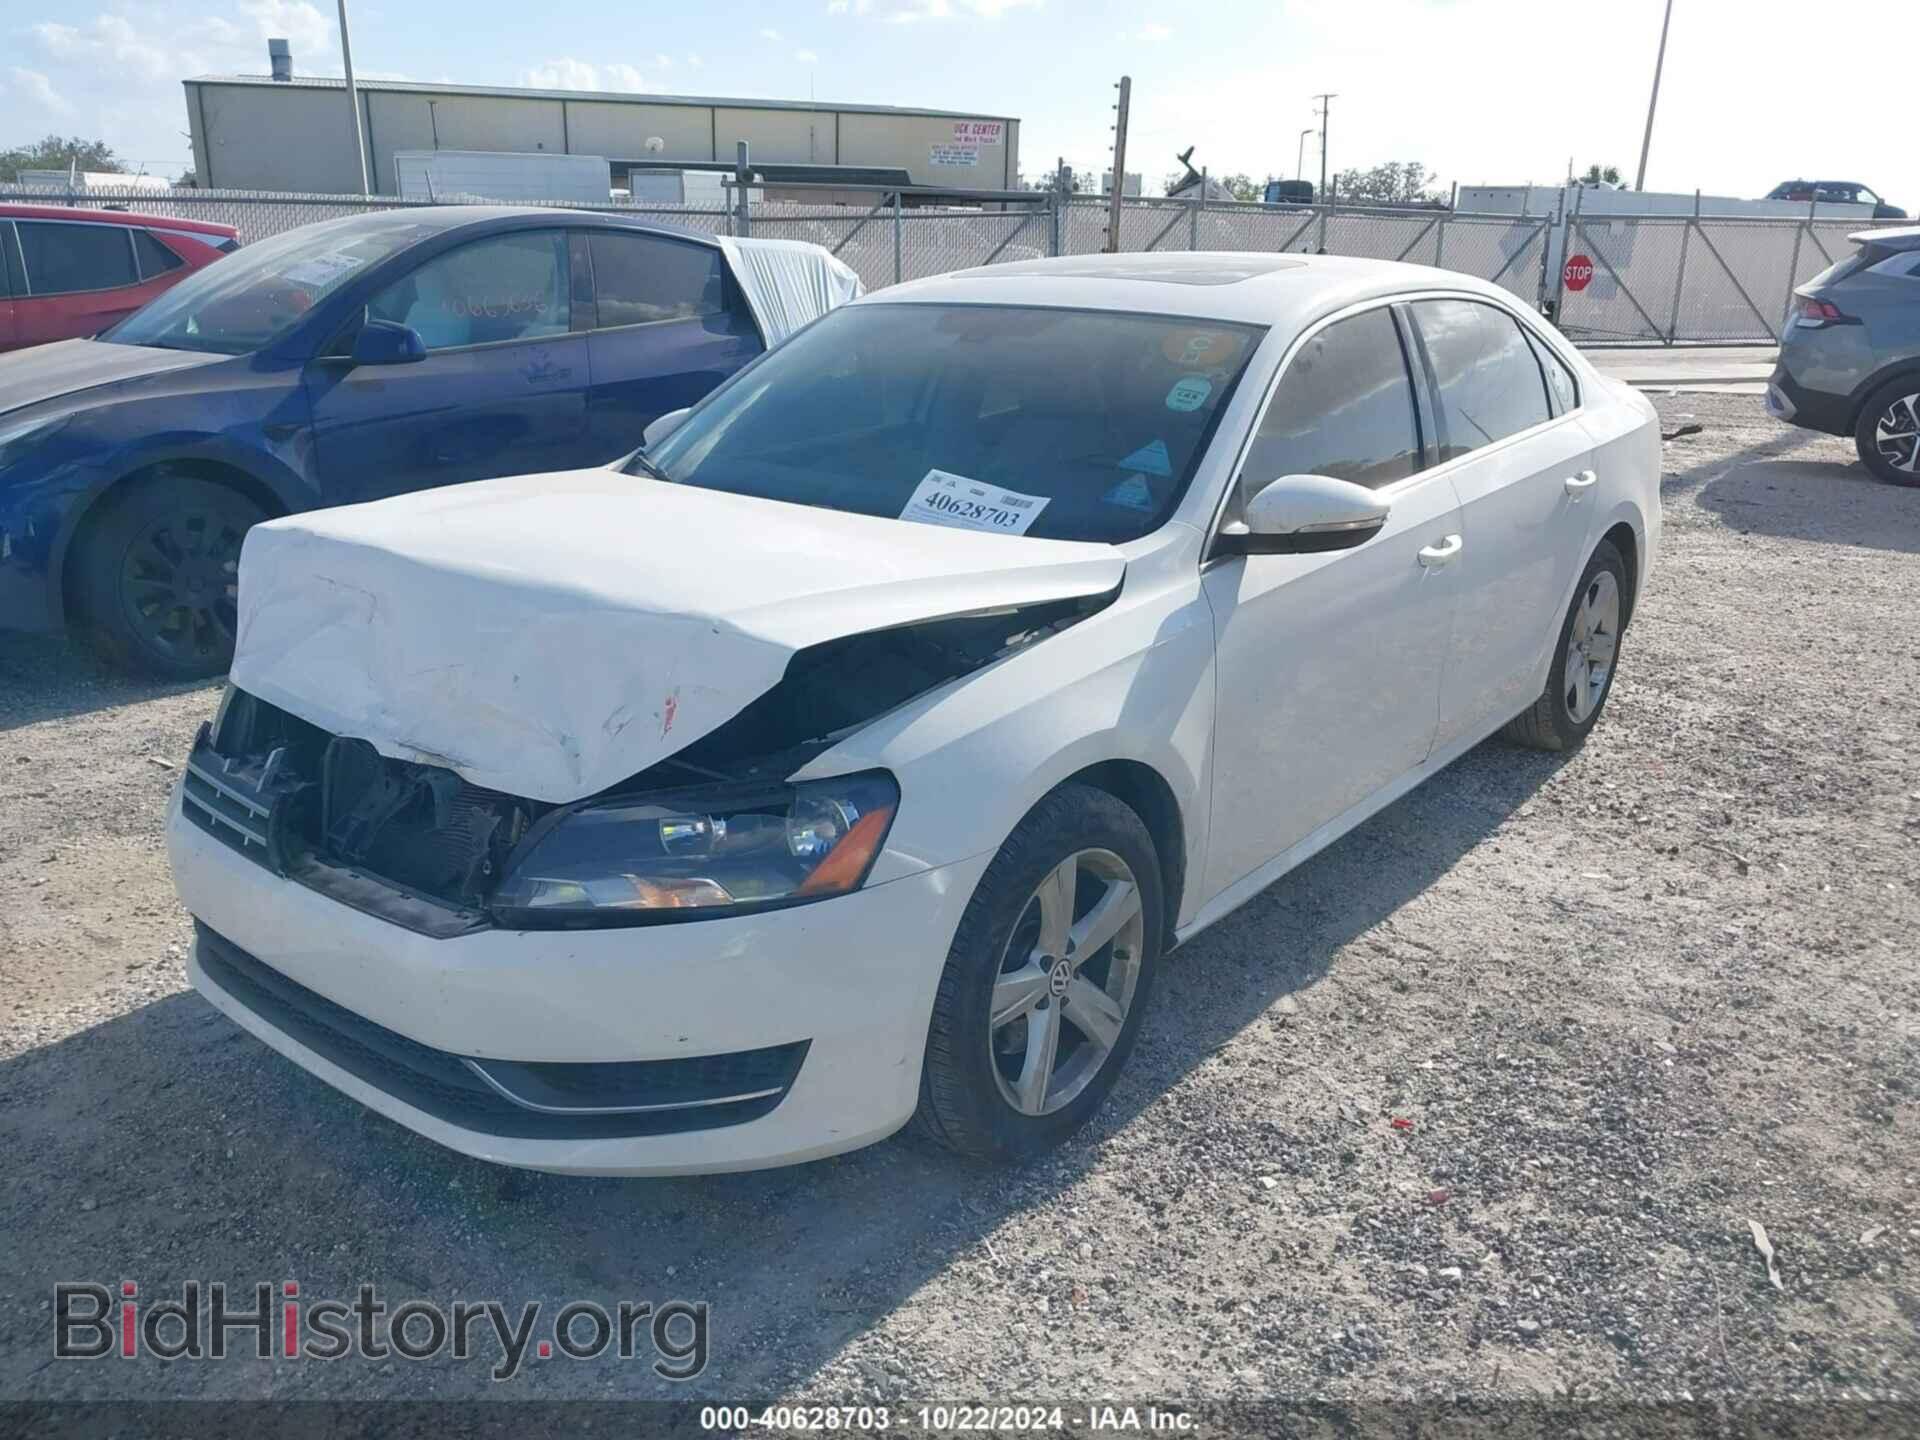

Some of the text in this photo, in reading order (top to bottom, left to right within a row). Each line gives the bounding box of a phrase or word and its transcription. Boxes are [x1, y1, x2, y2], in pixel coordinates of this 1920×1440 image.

[972, 122, 1001, 136] CENTER
[1564, 265, 1592, 281] STOP
[924, 491, 1020, 527] 40628703
